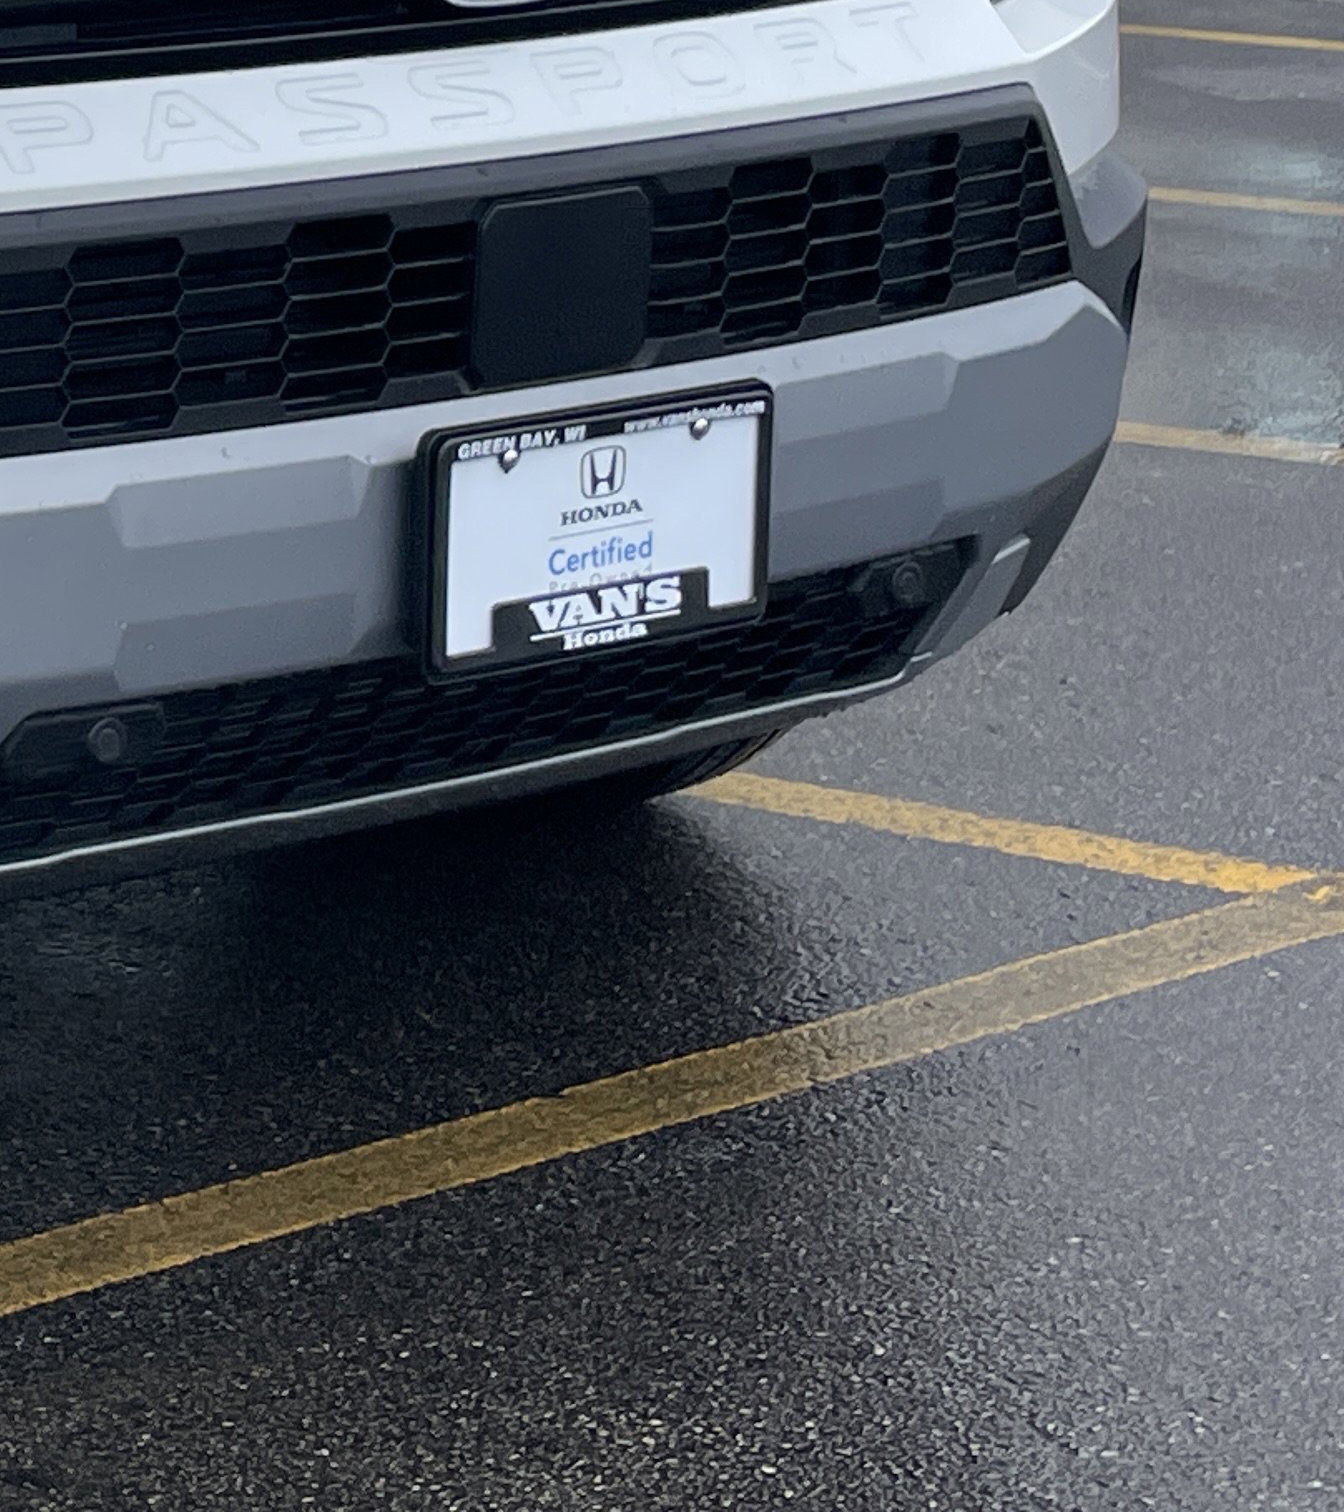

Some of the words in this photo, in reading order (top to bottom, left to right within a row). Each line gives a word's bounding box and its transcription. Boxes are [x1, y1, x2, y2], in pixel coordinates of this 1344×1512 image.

[457, 434, 517, 460] GREEN
[564, 424, 587, 443] WI
[560, 499, 643, 526] HONDA
[549, 529, 653, 575] Certified
[562, 621, 649, 651] Honda
